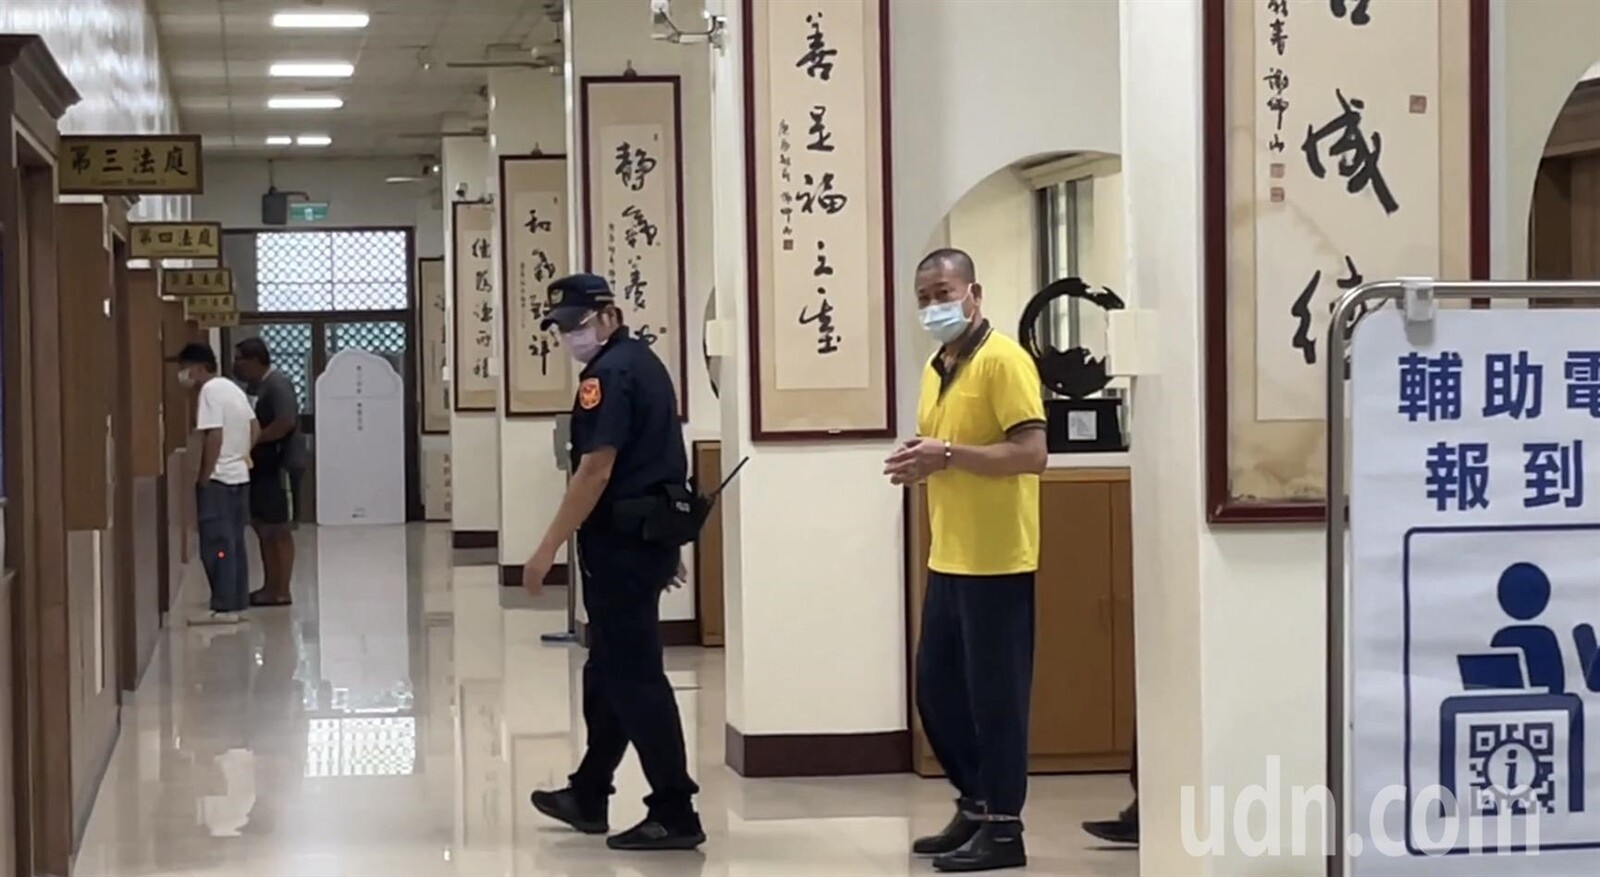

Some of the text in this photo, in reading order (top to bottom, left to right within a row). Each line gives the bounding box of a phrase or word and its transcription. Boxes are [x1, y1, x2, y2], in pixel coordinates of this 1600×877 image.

[70, 145, 189, 175] 第三法庭
[139, 228, 215, 247] 第四法庭
[1397, 350, 1600, 422] 輔助電
[1425, 439, 1585, 512] 報到
